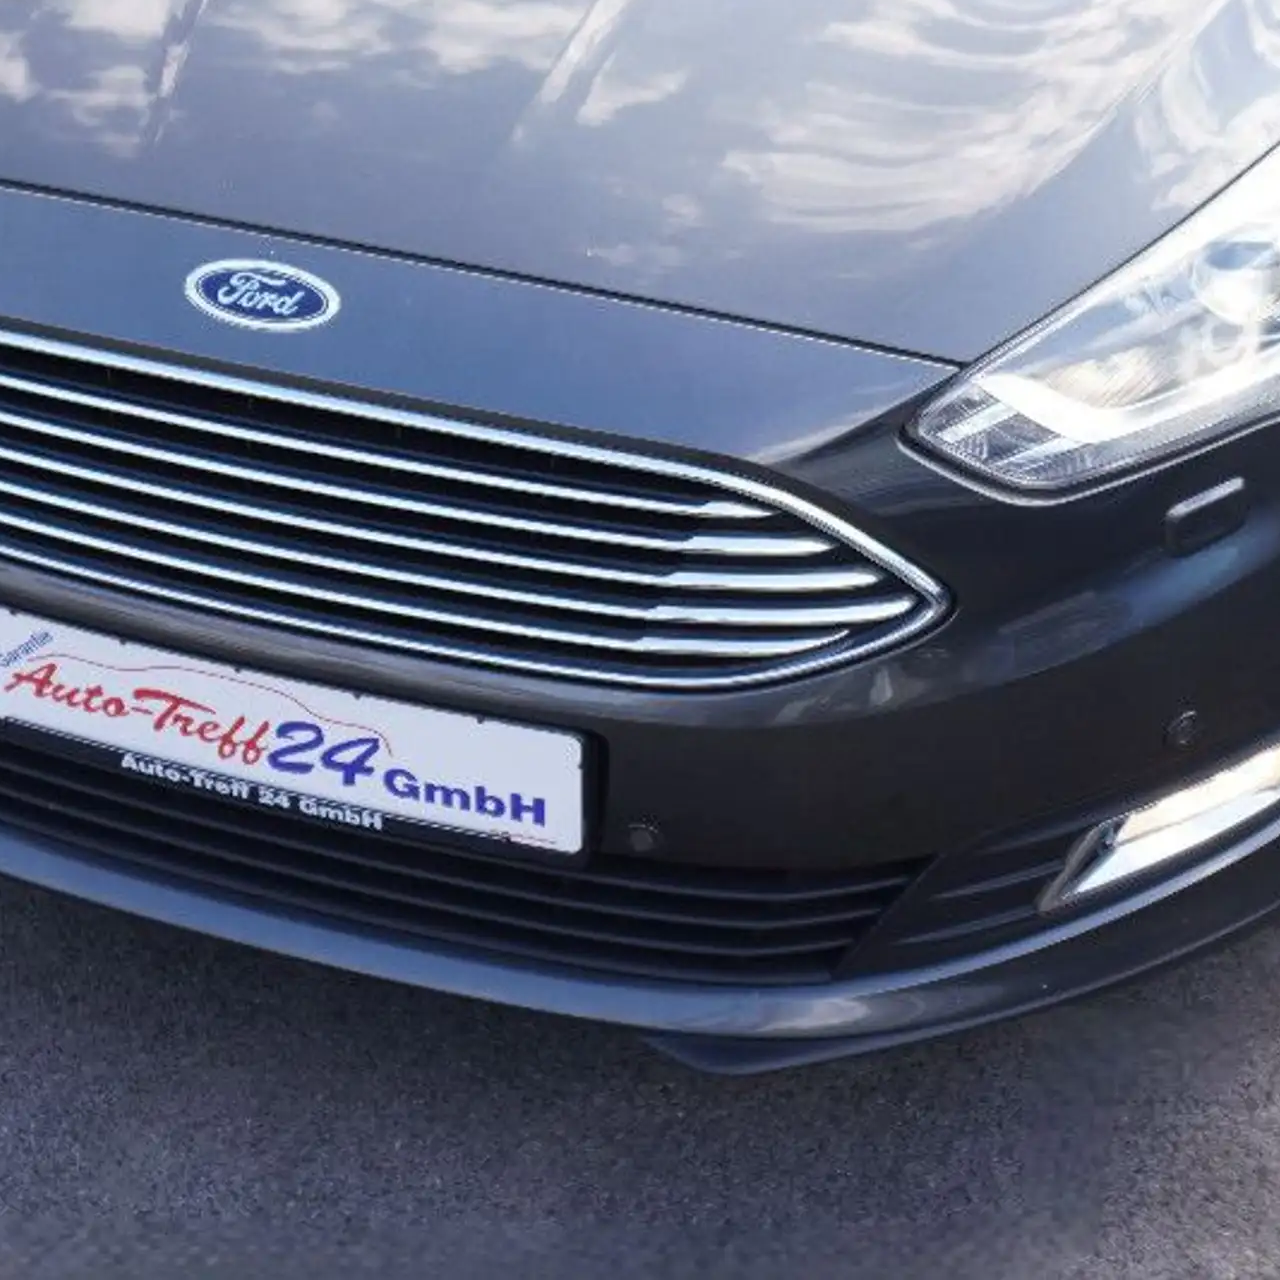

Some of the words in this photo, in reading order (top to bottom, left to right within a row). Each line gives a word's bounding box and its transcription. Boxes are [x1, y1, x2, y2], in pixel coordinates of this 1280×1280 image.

[218, 272, 304, 316] Ford
[121, 752, 231, 800] Auto-Treff
[258, 784, 291, 810] 24
[299, 797, 383, 831] GmbH
[383, 768, 546, 827] GmbH
